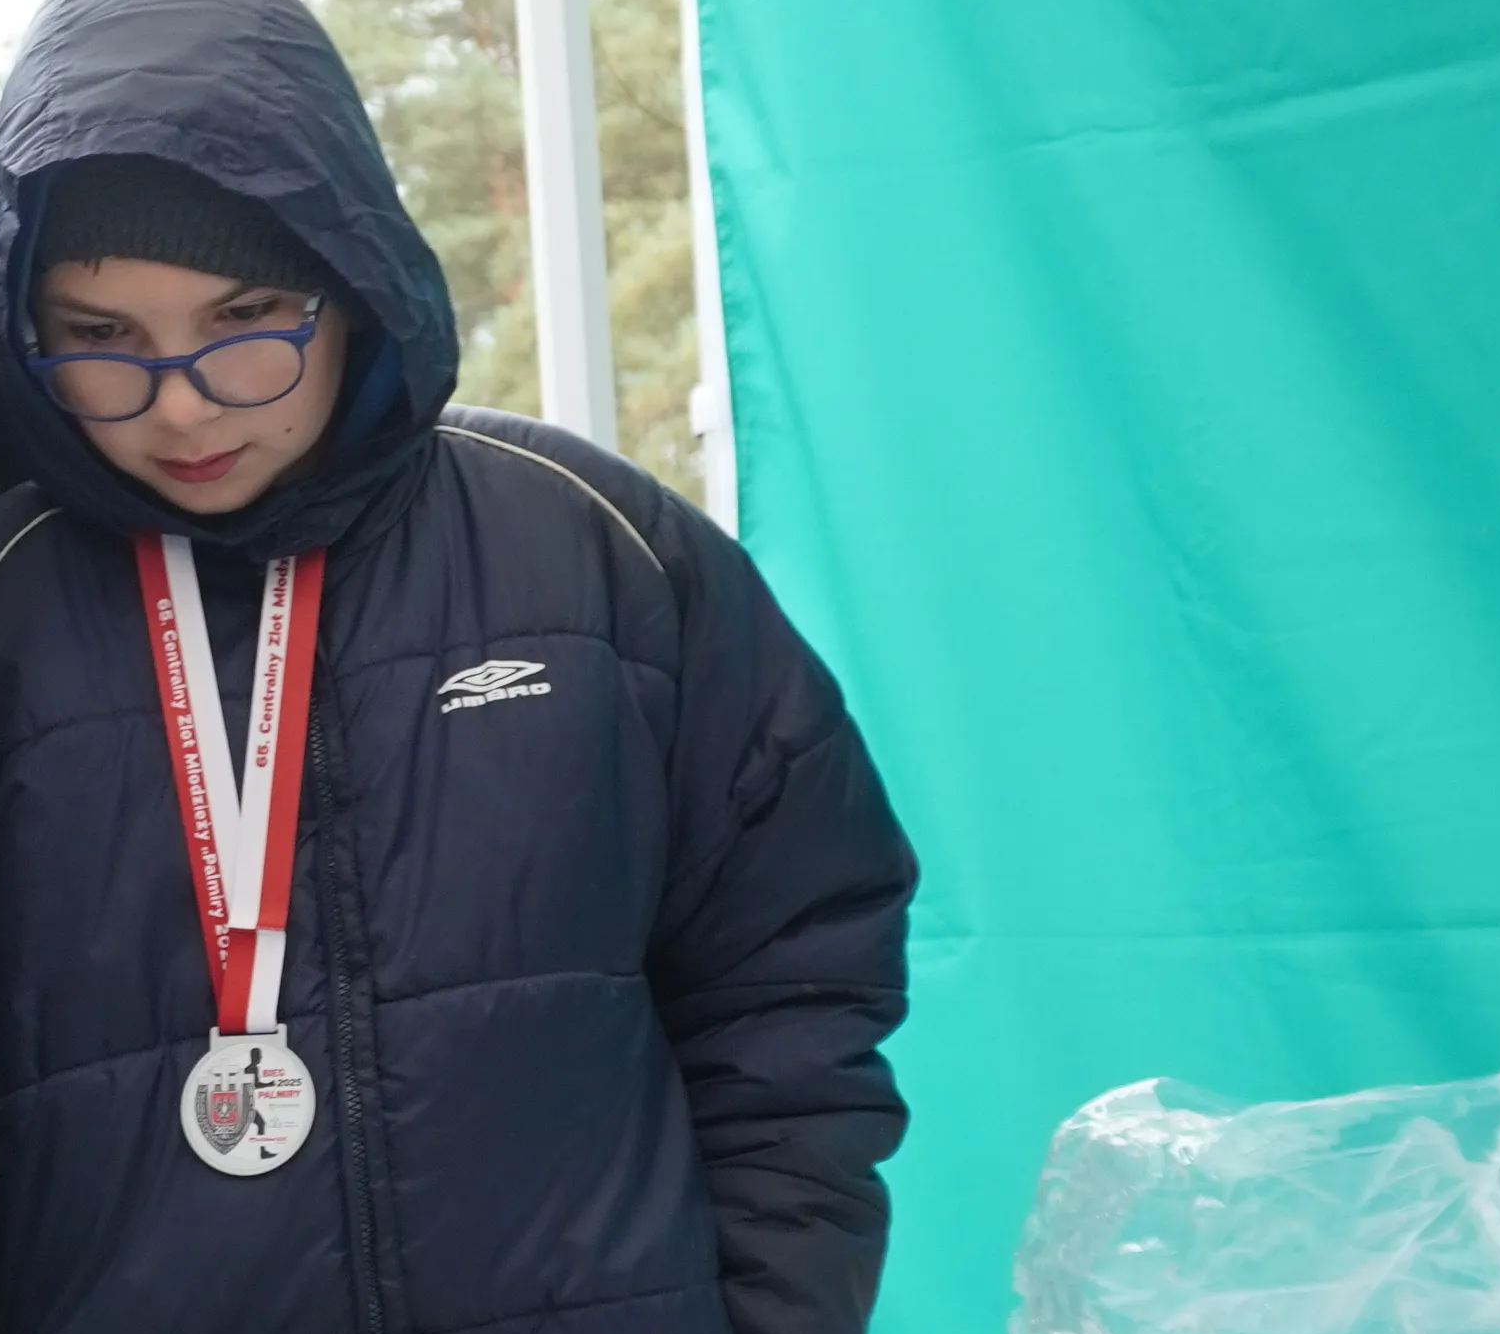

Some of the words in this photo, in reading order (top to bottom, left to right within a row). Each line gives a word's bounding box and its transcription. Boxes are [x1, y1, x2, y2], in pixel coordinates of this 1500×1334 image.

[267, 613, 284, 647] Zlot
[162, 630, 188, 711] Centralny
[177, 713, 198, 749] Zlot
[258, 653, 283, 734] Centralny
